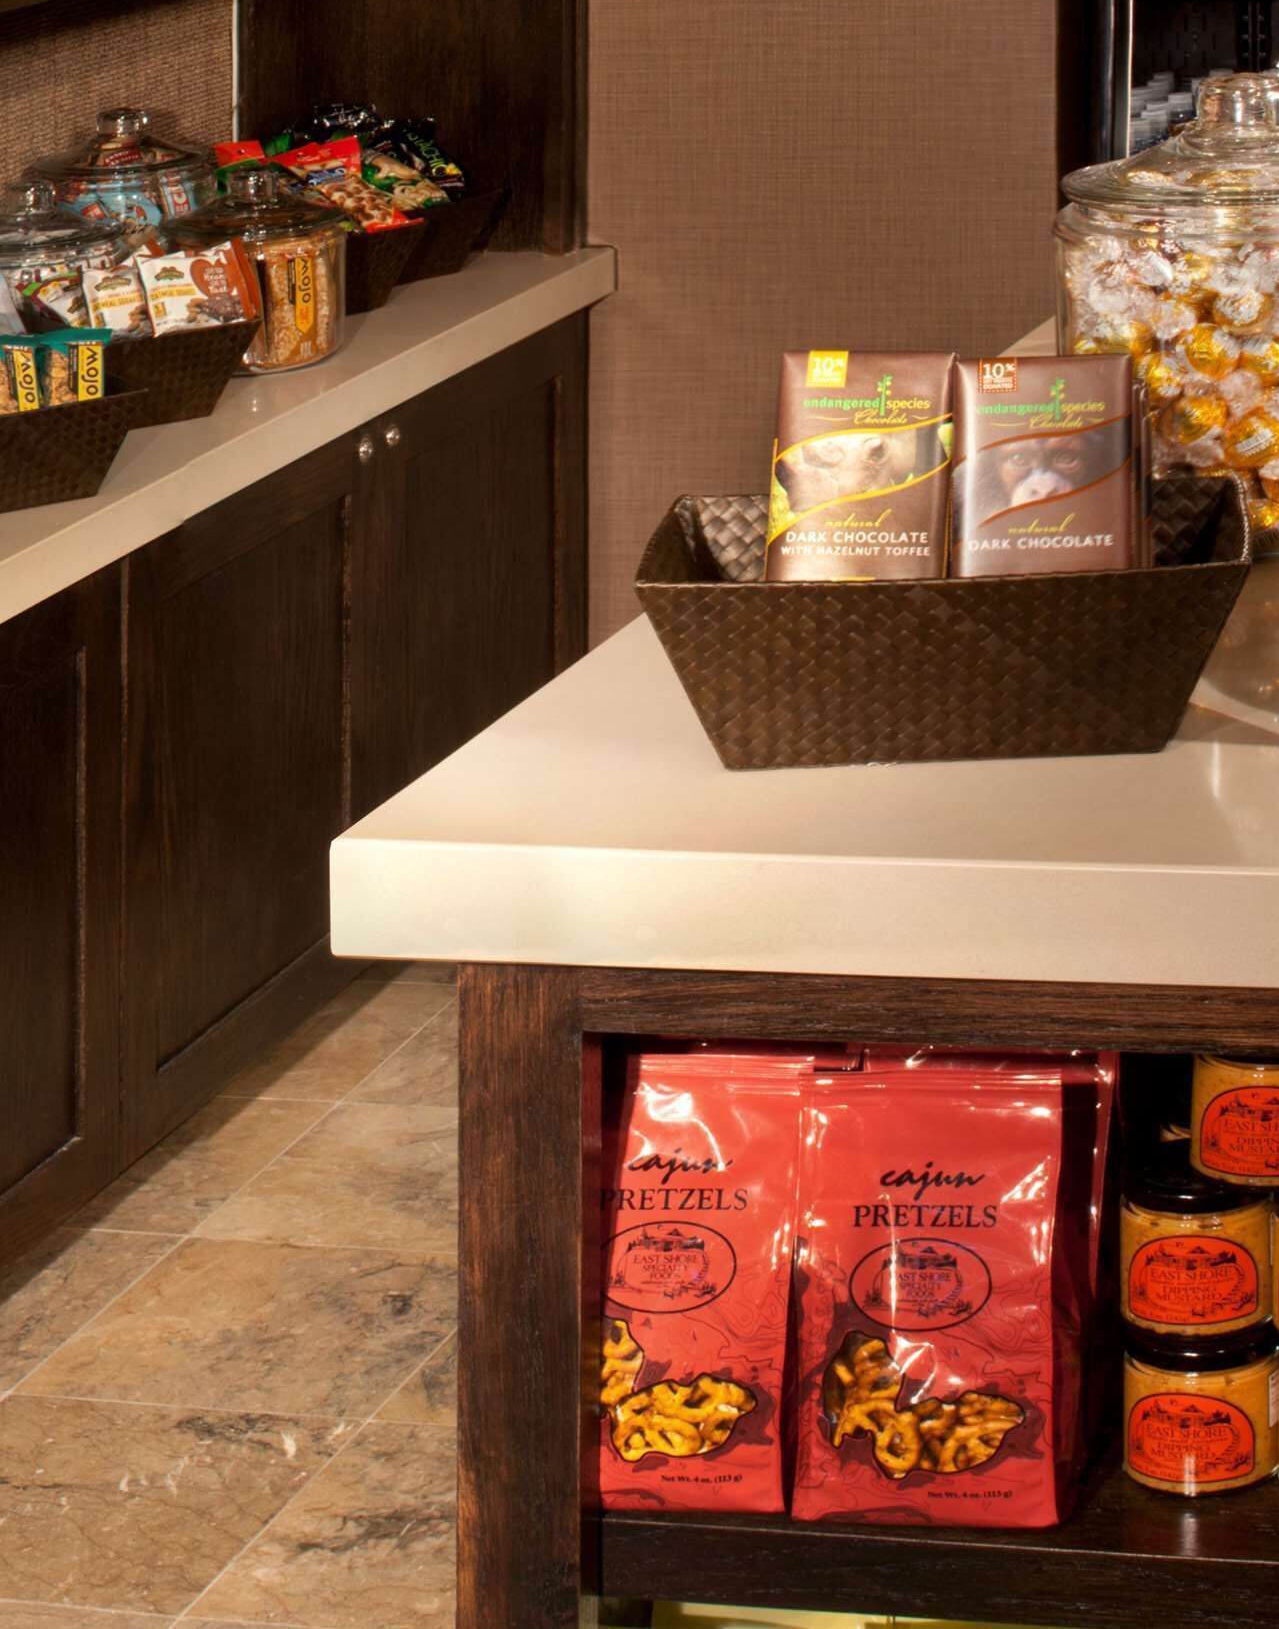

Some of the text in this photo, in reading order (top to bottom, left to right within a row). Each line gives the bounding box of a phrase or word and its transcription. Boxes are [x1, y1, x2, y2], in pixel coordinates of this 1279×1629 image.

[812, 356, 846, 372] 10%
[982, 362, 1017, 379] 10%
[803, 397, 932, 411] endangered species
[976, 400, 1106, 416] endangered species
[785, 530, 930, 544] DARK CHOCOLATE
[968, 534, 1114, 552] DARK CHOCOLATE
[780, 545, 931, 557] WITH HAZELNUT TOFFEE
[1222, 1119, 1255, 1132] EAST
[879, 1160, 985, 1201] cajun
[600, 1187, 749, 1211] PRETZELS
[852, 1204, 998, 1228] PRETZELS
[633, 1253, 699, 1265] EAST SHORE
[923, 1271, 953, 1283] SHORE
[1150, 1268, 1232, 1281] EAST SHORE
[1161, 1285, 1217, 1295] DIPPING
[1154, 1292, 1222, 1303] MUSTARD
[1145, 1425, 1226, 1439] EAST SHORE
[660, 1474, 676, 1483] Net
